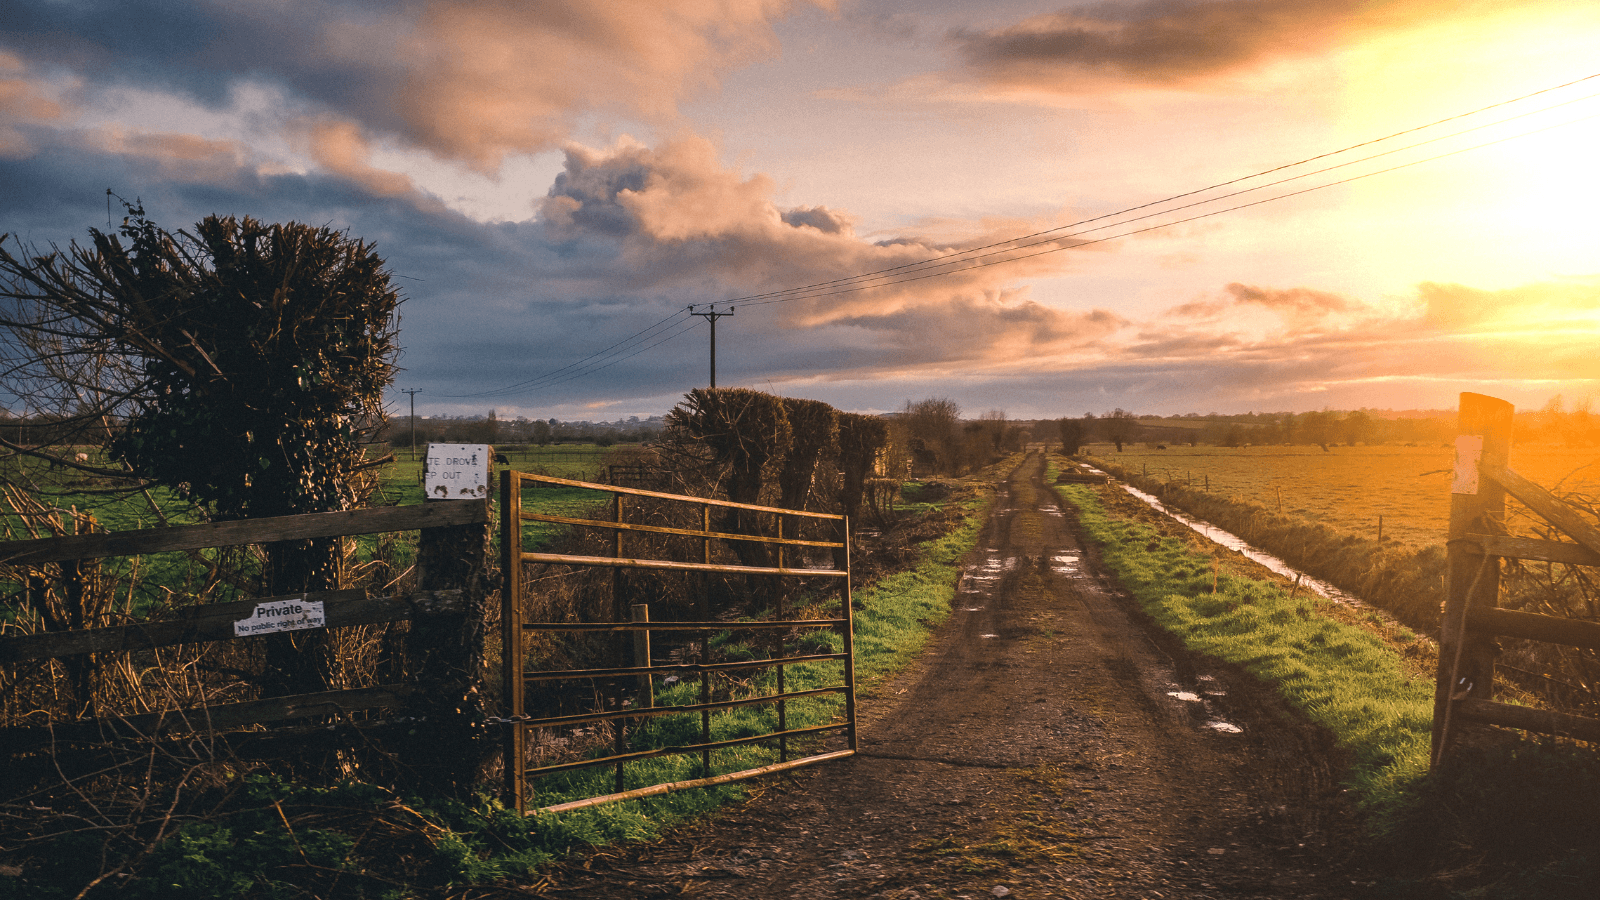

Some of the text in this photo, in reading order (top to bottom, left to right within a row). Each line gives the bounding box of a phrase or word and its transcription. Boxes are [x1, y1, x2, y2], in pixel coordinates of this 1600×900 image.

[442, 471, 462, 480] OUT
[257, 604, 303, 618] Private
[251, 621, 275, 631] public
[277, 619, 295, 629] right
[306, 617, 323, 625] way
